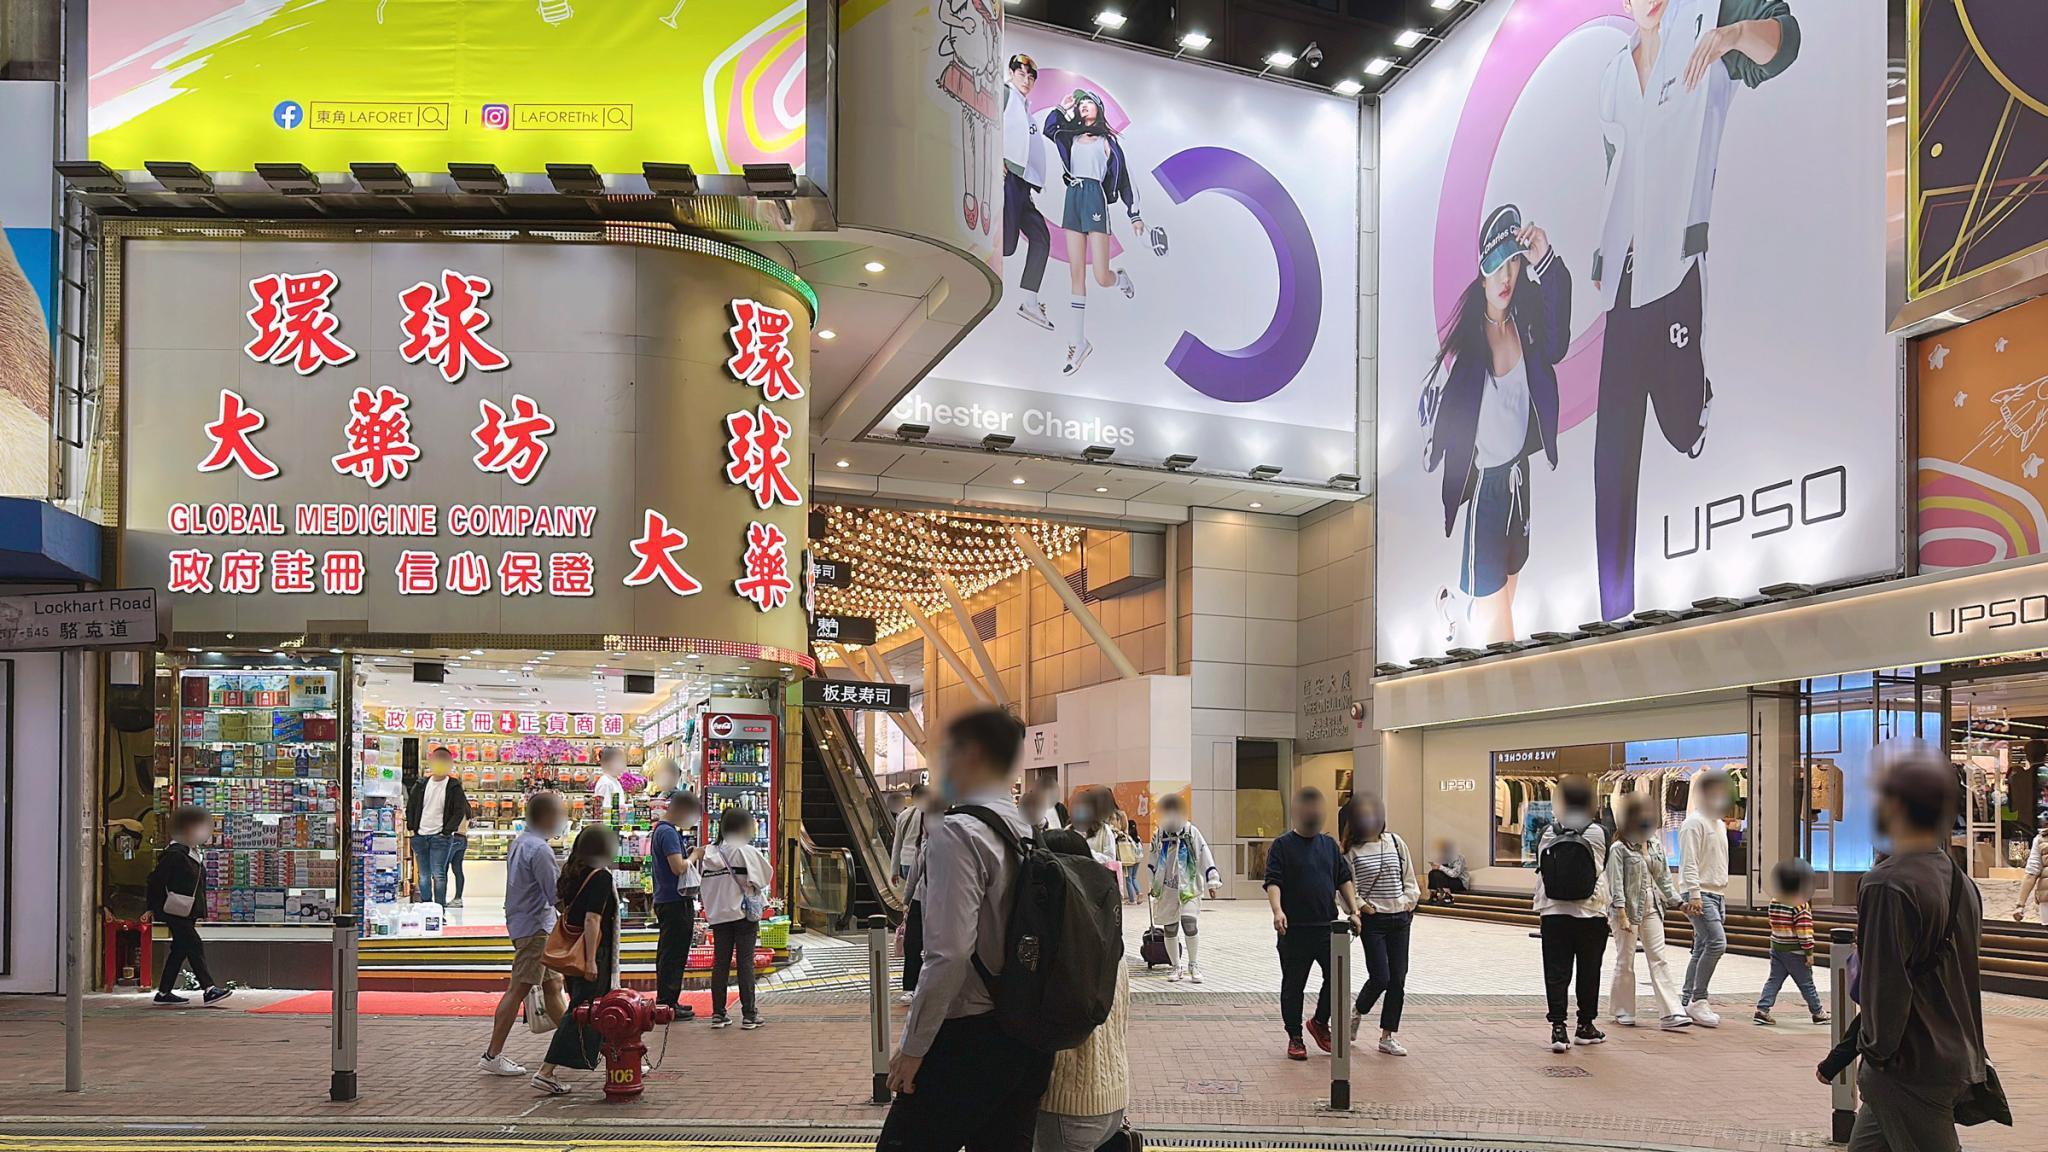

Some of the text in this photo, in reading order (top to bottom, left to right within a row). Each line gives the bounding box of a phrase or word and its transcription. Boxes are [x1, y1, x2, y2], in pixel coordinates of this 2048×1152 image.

[317, 110, 413, 124] 東角 LAFORET
[521, 110, 598, 123] LAFOREThk
[1484, 229, 1509, 254] Charles
[249, 273, 504, 378] 環球
[891, 394, 1135, 447] Chester Charles
[203, 390, 554, 484] 大藥坊
[170, 505, 594, 537] GLOBAL MEDICINE COMPANY
[1665, 466, 1847, 560] UPSO
[170, 551, 594, 594] 政府註冊 信心保證
[34, 596, 151, 615] Lockhart Road
[1929, 594, 2048, 637] UPSO
[59, 620, 128, 639] 駱克道
[822, 684, 891, 705] 板長寿司
[386, 711, 492, 731] 政府註冊
[1440, 778, 1476, 792] UPSO
[608, 1069, 634, 1084] 106
